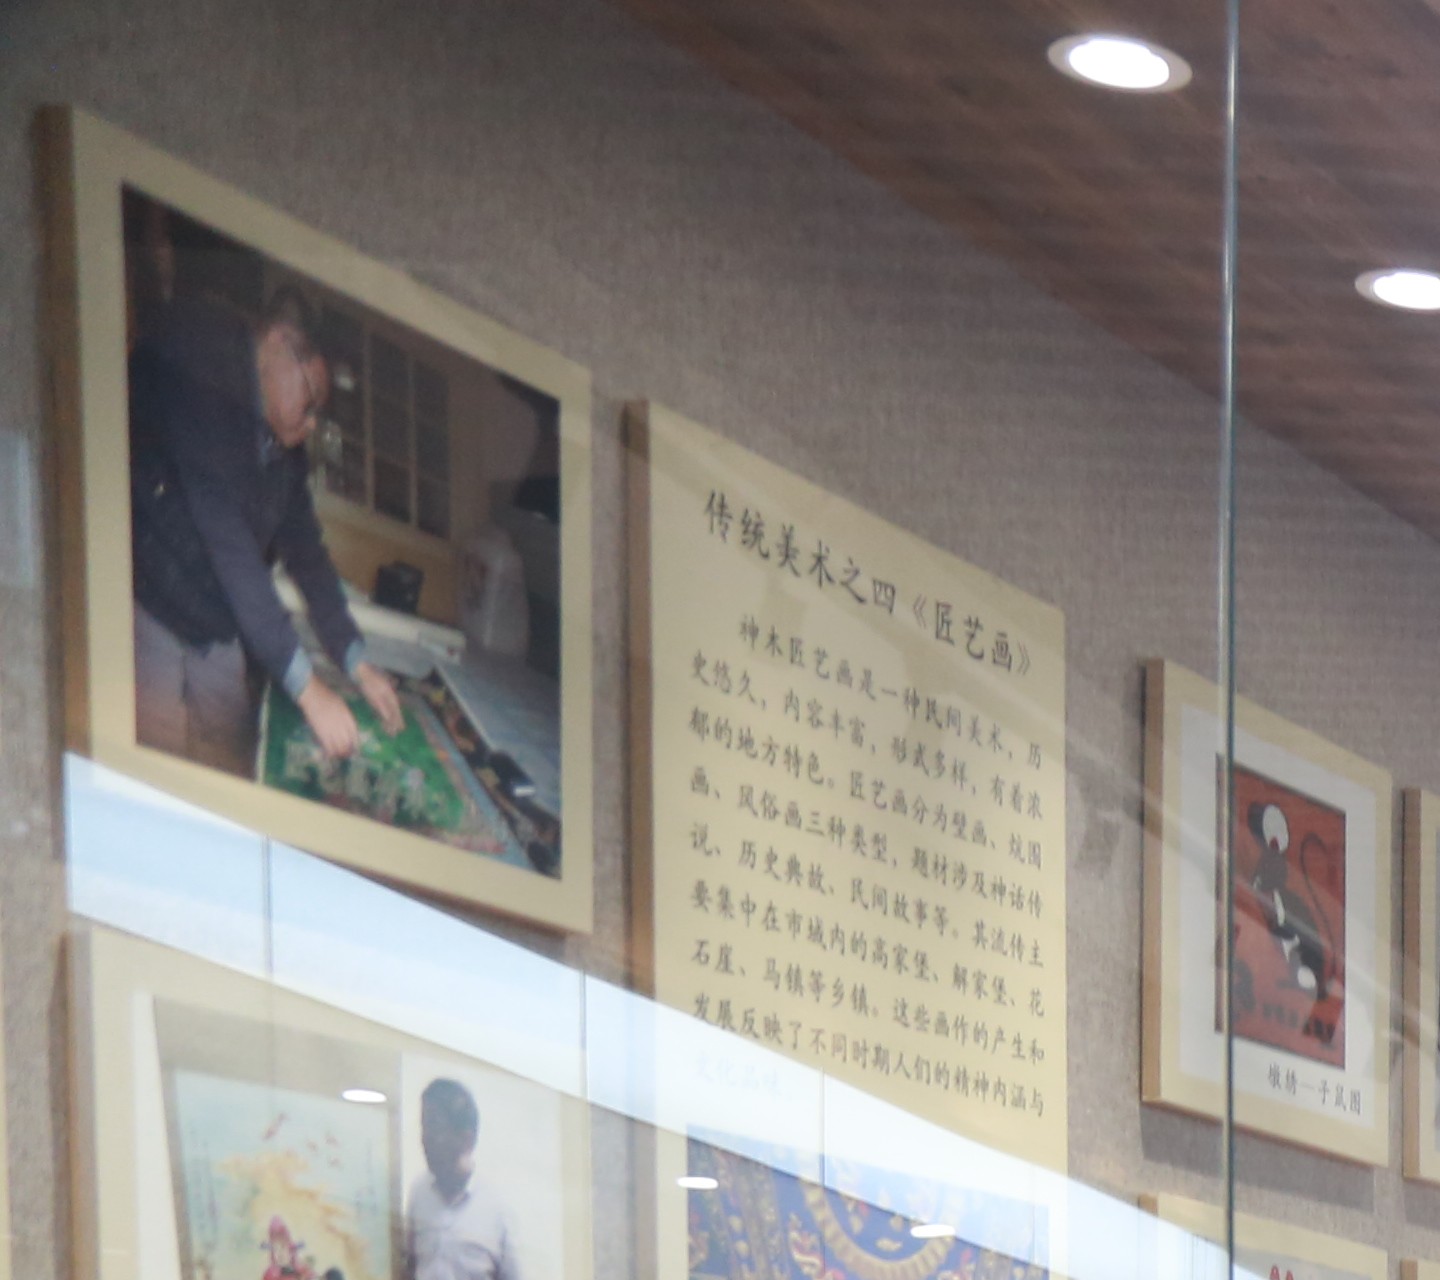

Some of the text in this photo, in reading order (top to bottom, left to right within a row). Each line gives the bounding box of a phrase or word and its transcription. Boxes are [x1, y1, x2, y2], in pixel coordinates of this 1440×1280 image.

[703, 490, 1032, 675] 传统美术之四《匠艺画》
